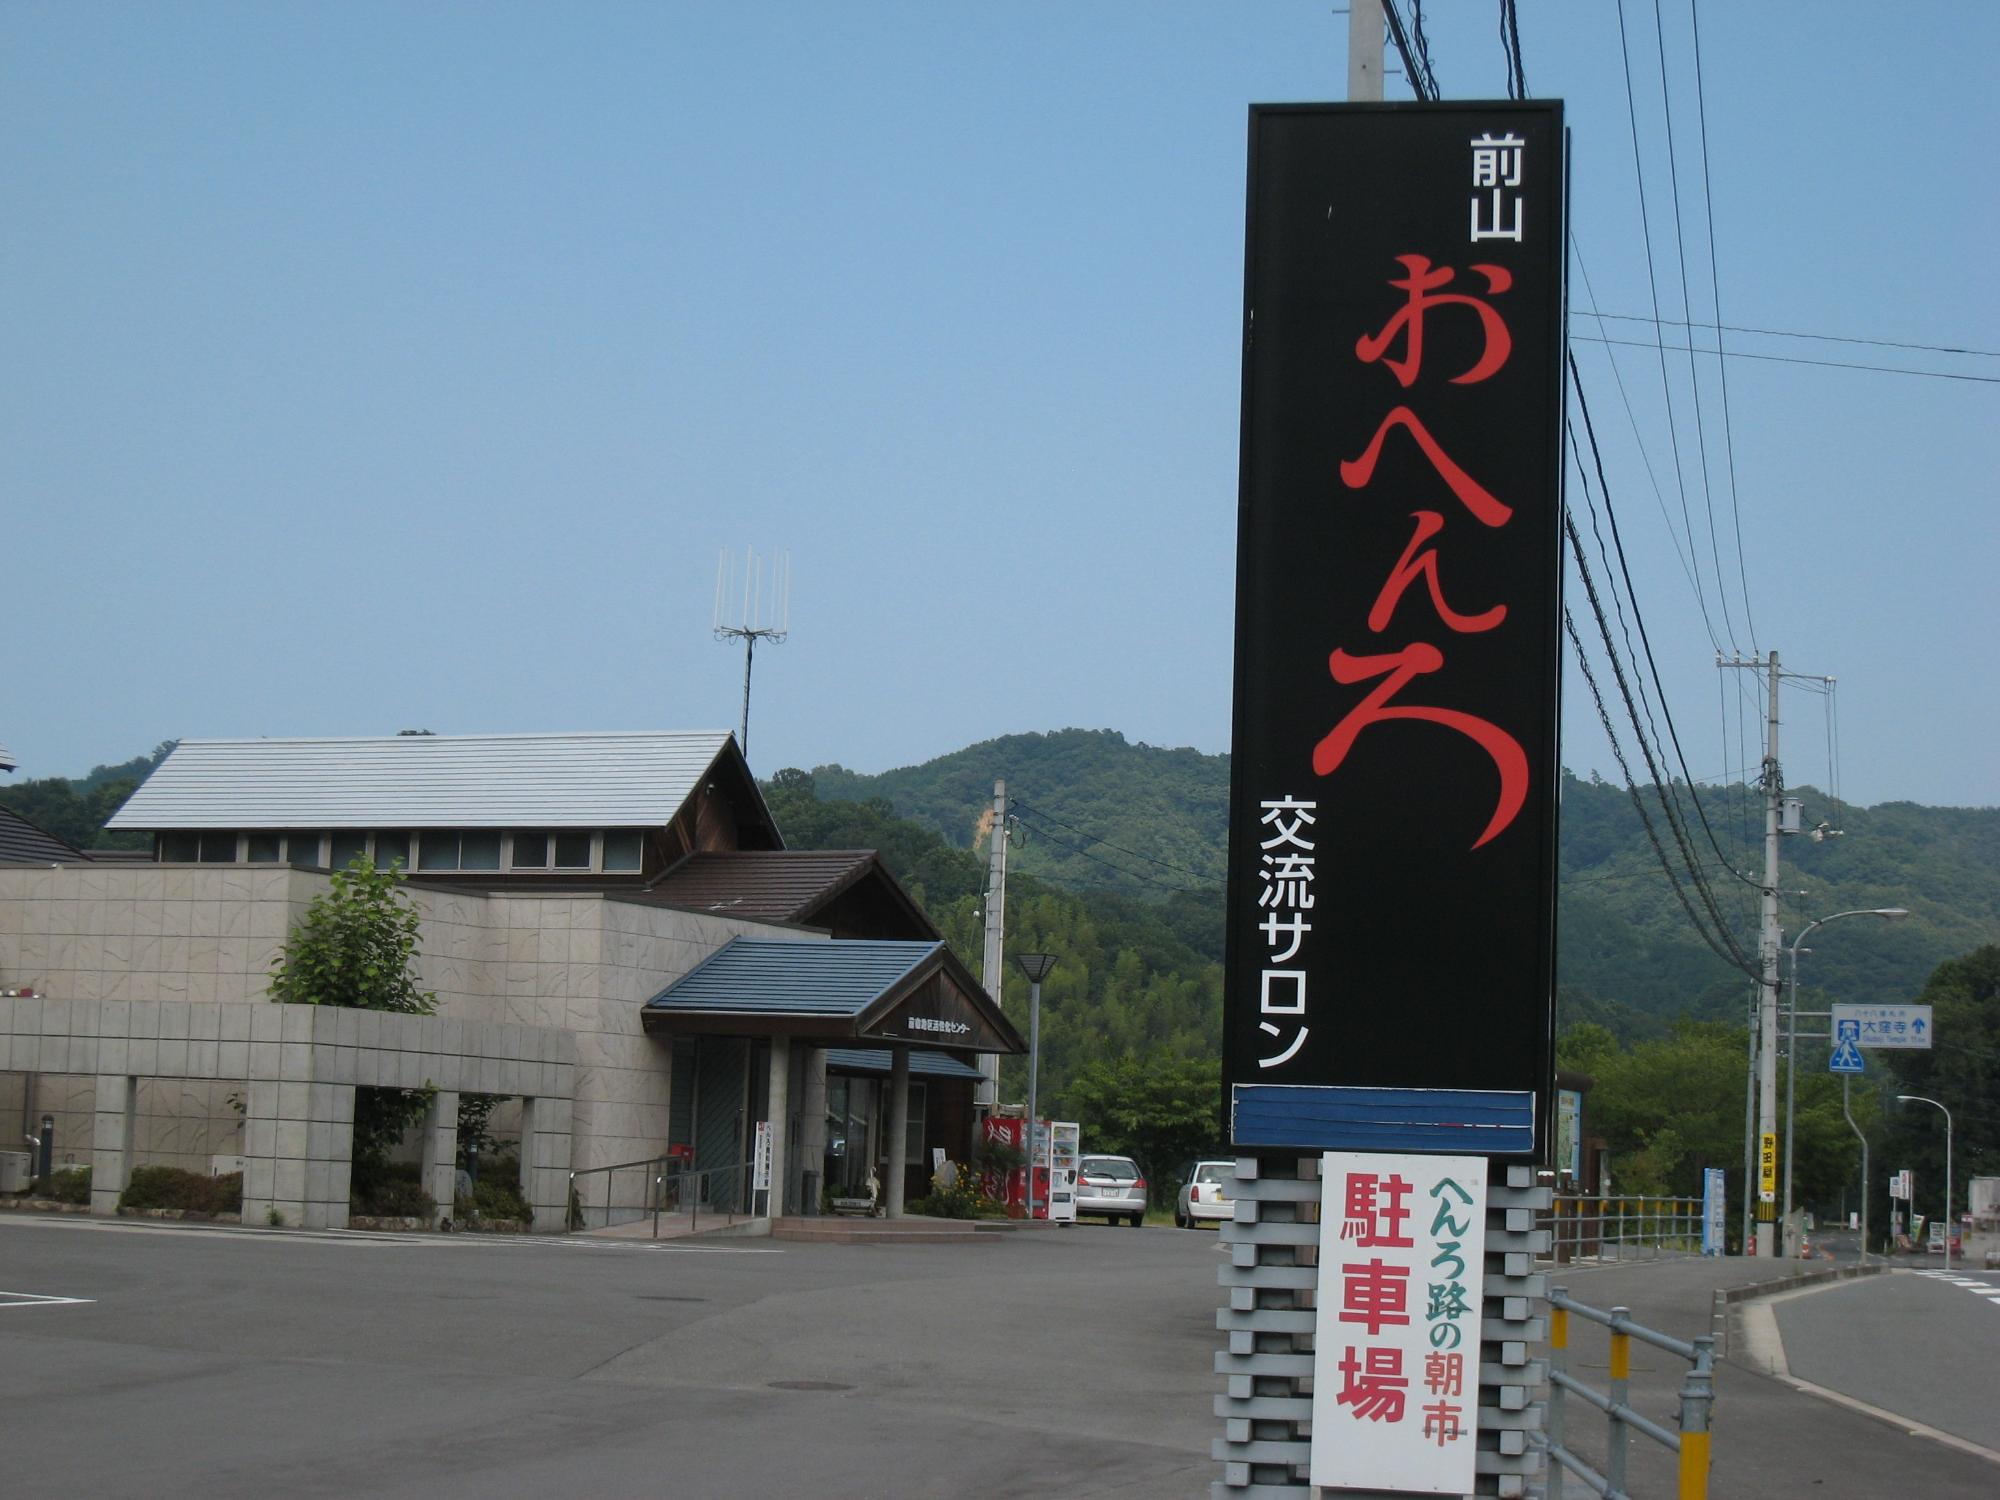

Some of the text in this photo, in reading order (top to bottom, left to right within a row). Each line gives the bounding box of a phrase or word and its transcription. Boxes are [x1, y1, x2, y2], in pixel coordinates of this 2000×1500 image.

[1470, 132, 1525, 243] 前山
[1312, 253, 1530, 849] おへんろ
[1258, 794, 1317, 1068] 交流サロン
[1862, 1020, 1907, 1035] 大窪寺
[1337, 1173, 1415, 1423] 駐車場
[1422, 1176, 1475, 1447] へんろ路の朝市
